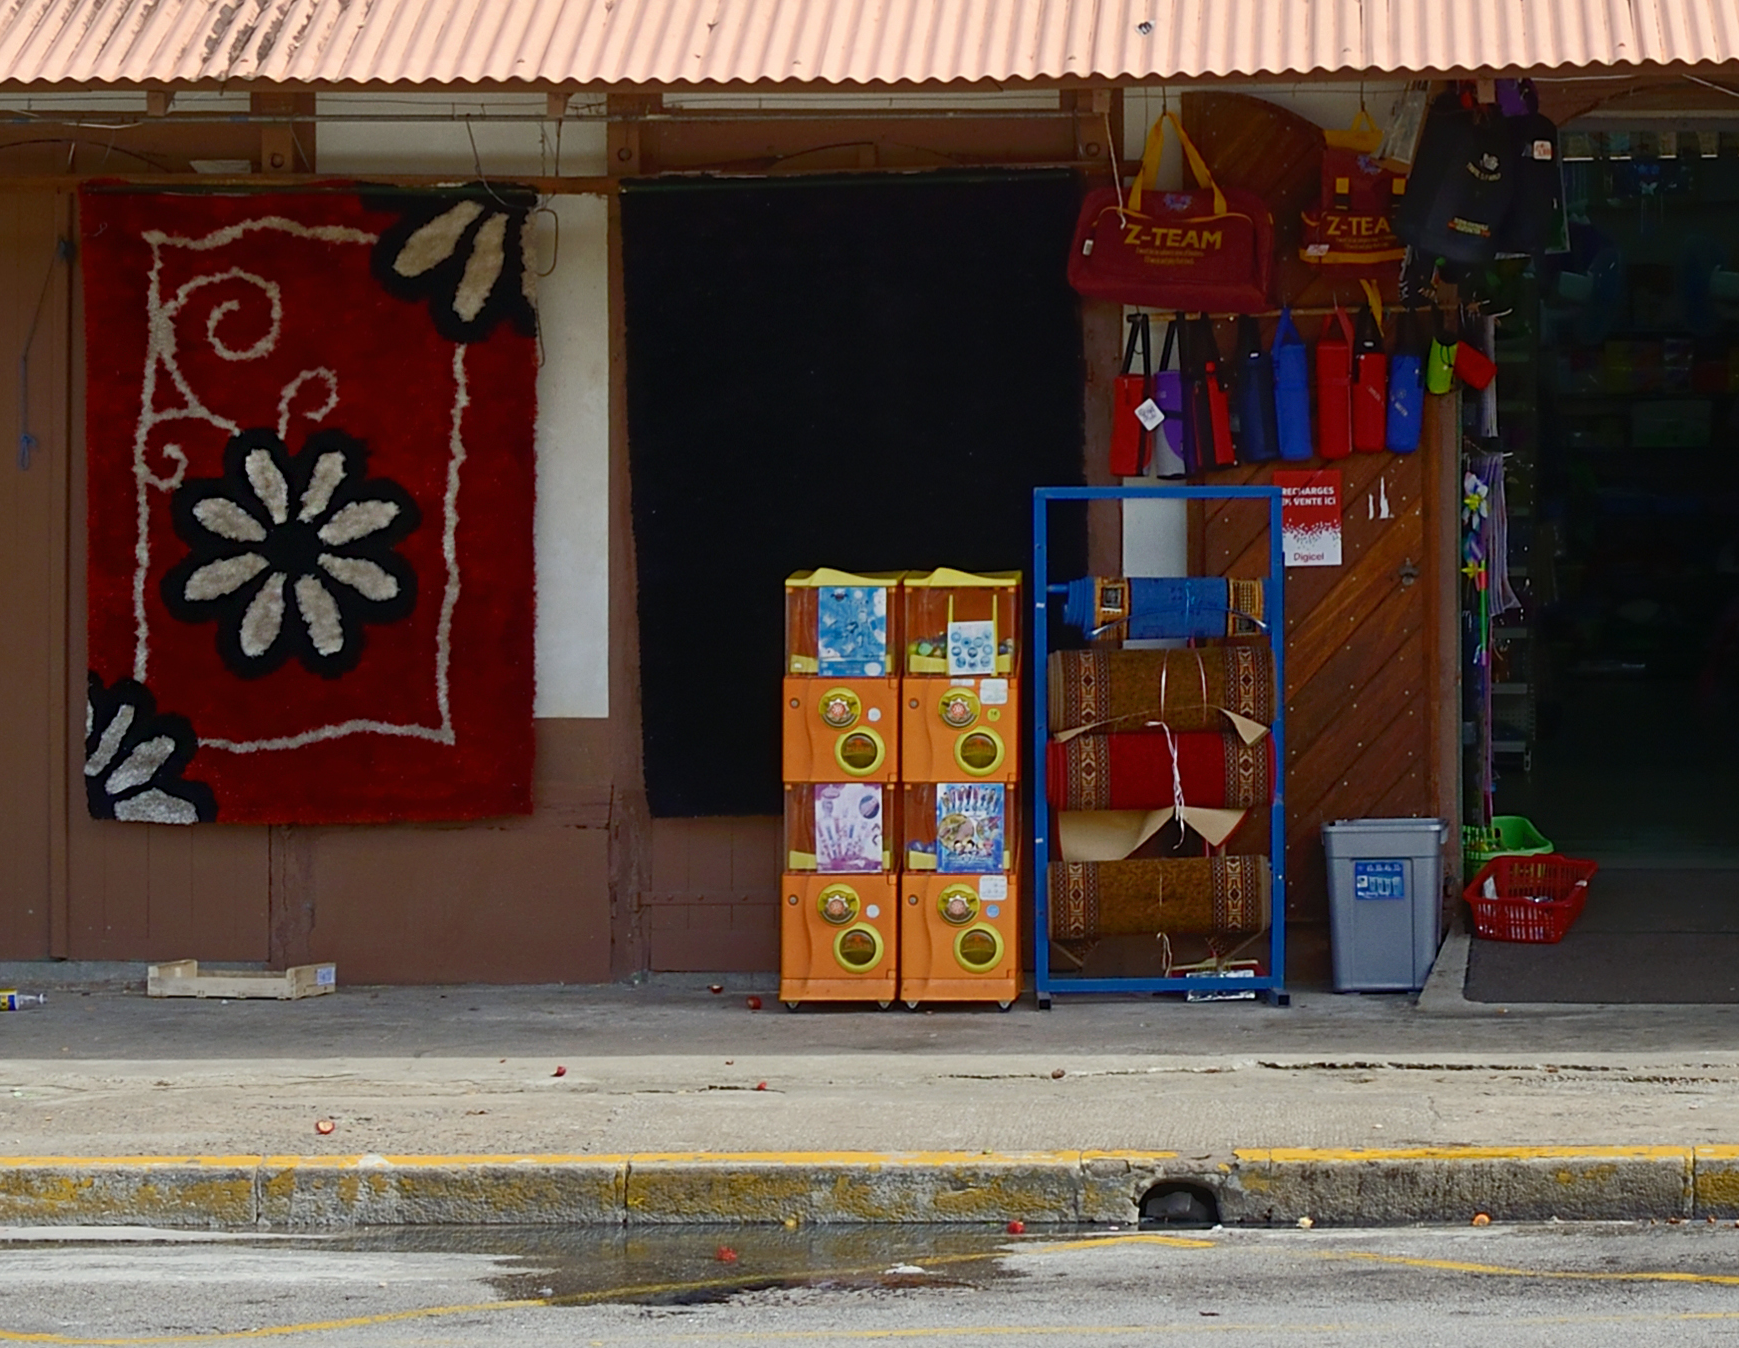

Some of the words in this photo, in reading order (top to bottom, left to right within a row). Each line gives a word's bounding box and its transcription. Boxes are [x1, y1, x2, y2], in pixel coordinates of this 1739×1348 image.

[1326, 215, 1391, 236] Z-TEA
[1124, 223, 1222, 251] Z-TEAM
[1293, 496, 1322, 506] VENTE
[1294, 552, 1325, 563] Digicel
